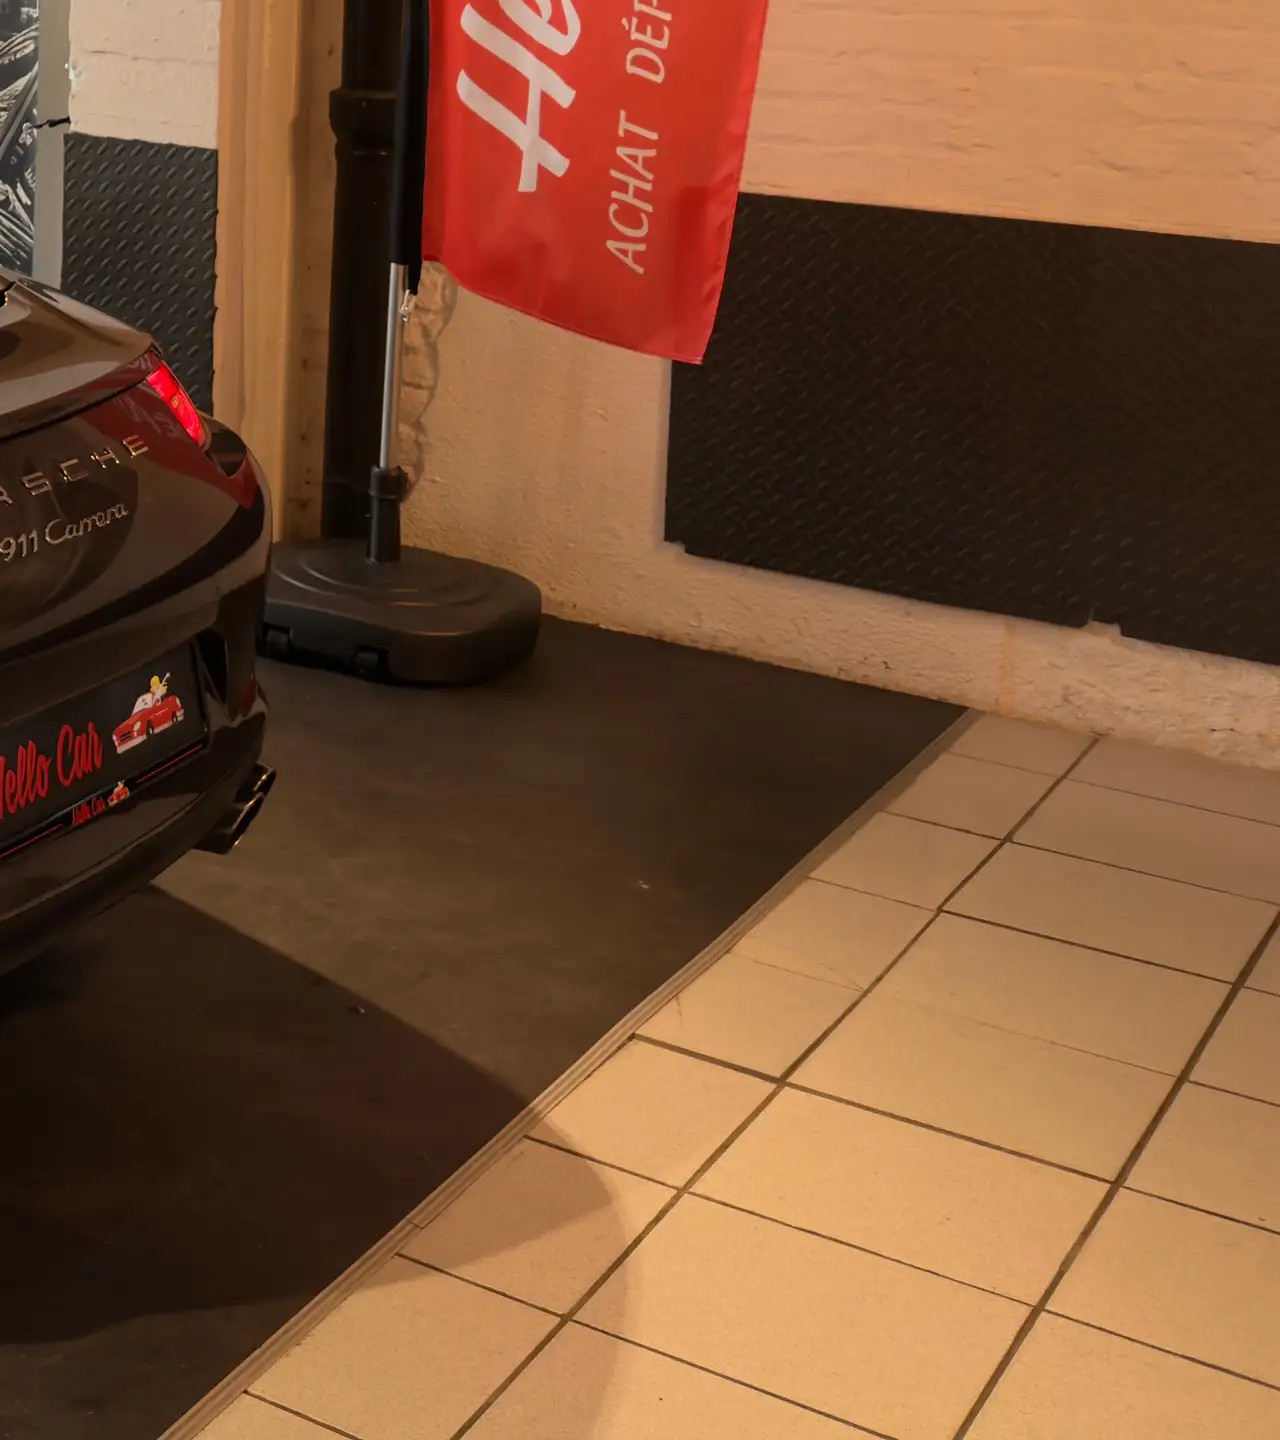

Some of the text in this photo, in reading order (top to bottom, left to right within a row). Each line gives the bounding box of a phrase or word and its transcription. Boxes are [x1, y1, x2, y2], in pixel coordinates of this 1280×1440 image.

[605, 110, 661, 275] ACHAT
[44, 502, 129, 545] Carrera
[57, 722, 103, 787] Car
